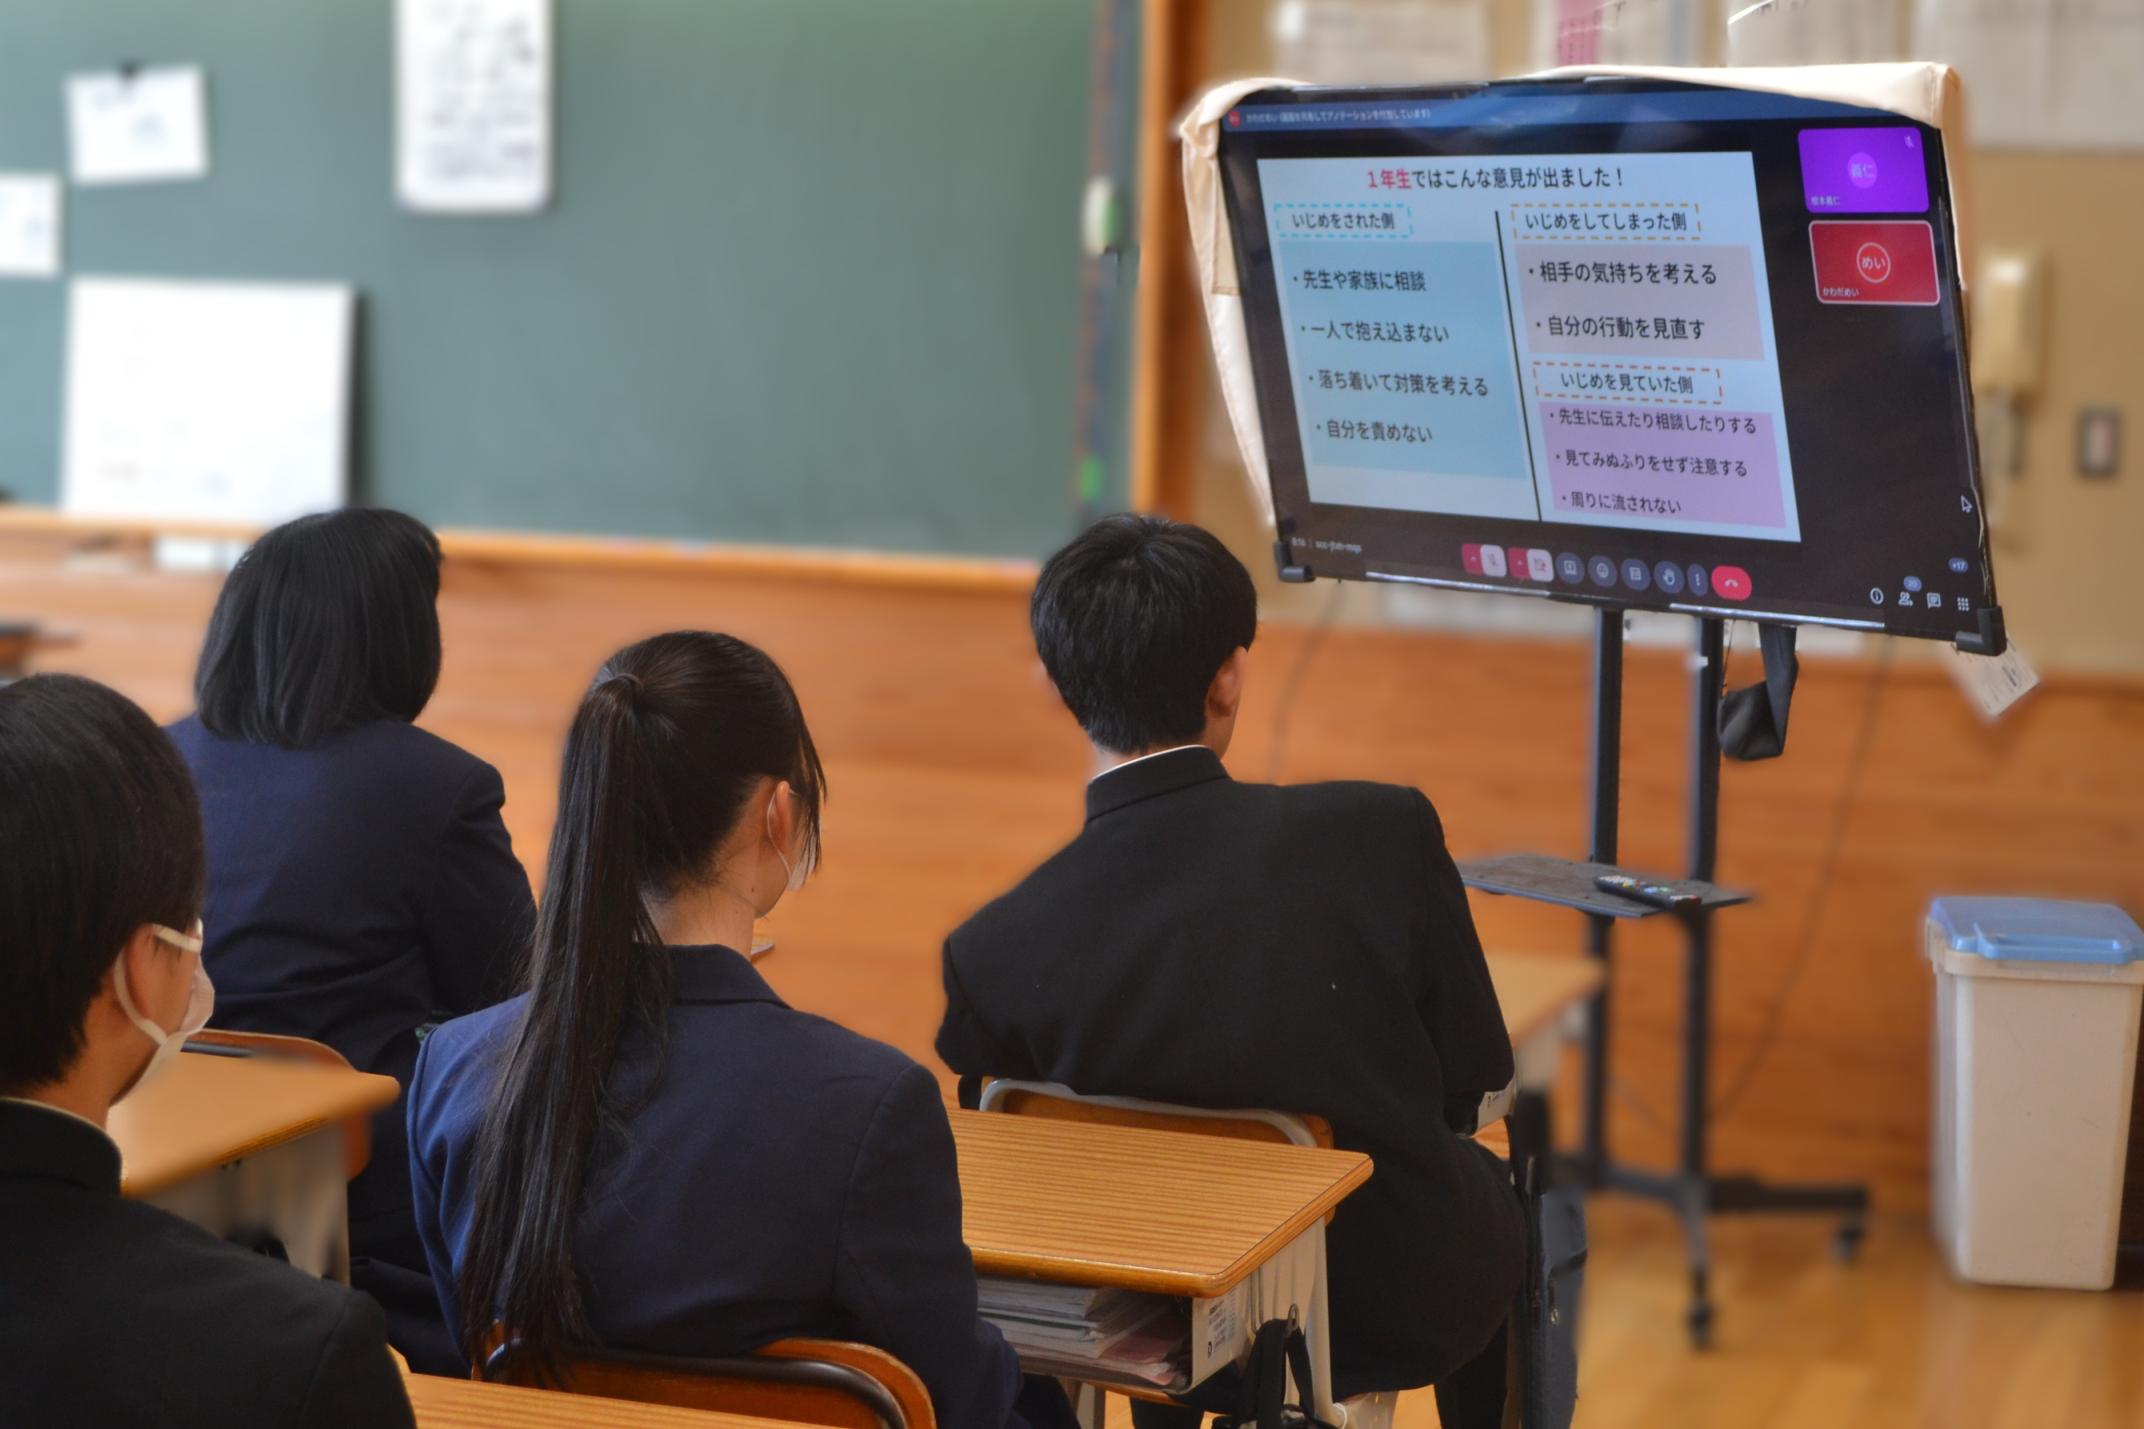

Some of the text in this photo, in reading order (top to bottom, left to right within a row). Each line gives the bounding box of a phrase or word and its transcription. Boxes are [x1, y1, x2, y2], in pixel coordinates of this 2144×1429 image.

[1292, 211, 1395, 231] いじめをされた側
[1526, 211, 1687, 232] いじめをしてしまった側
[1862, 258, 1886, 270] めい
[1560, 371, 1693, 395] いじめを見ていた側
